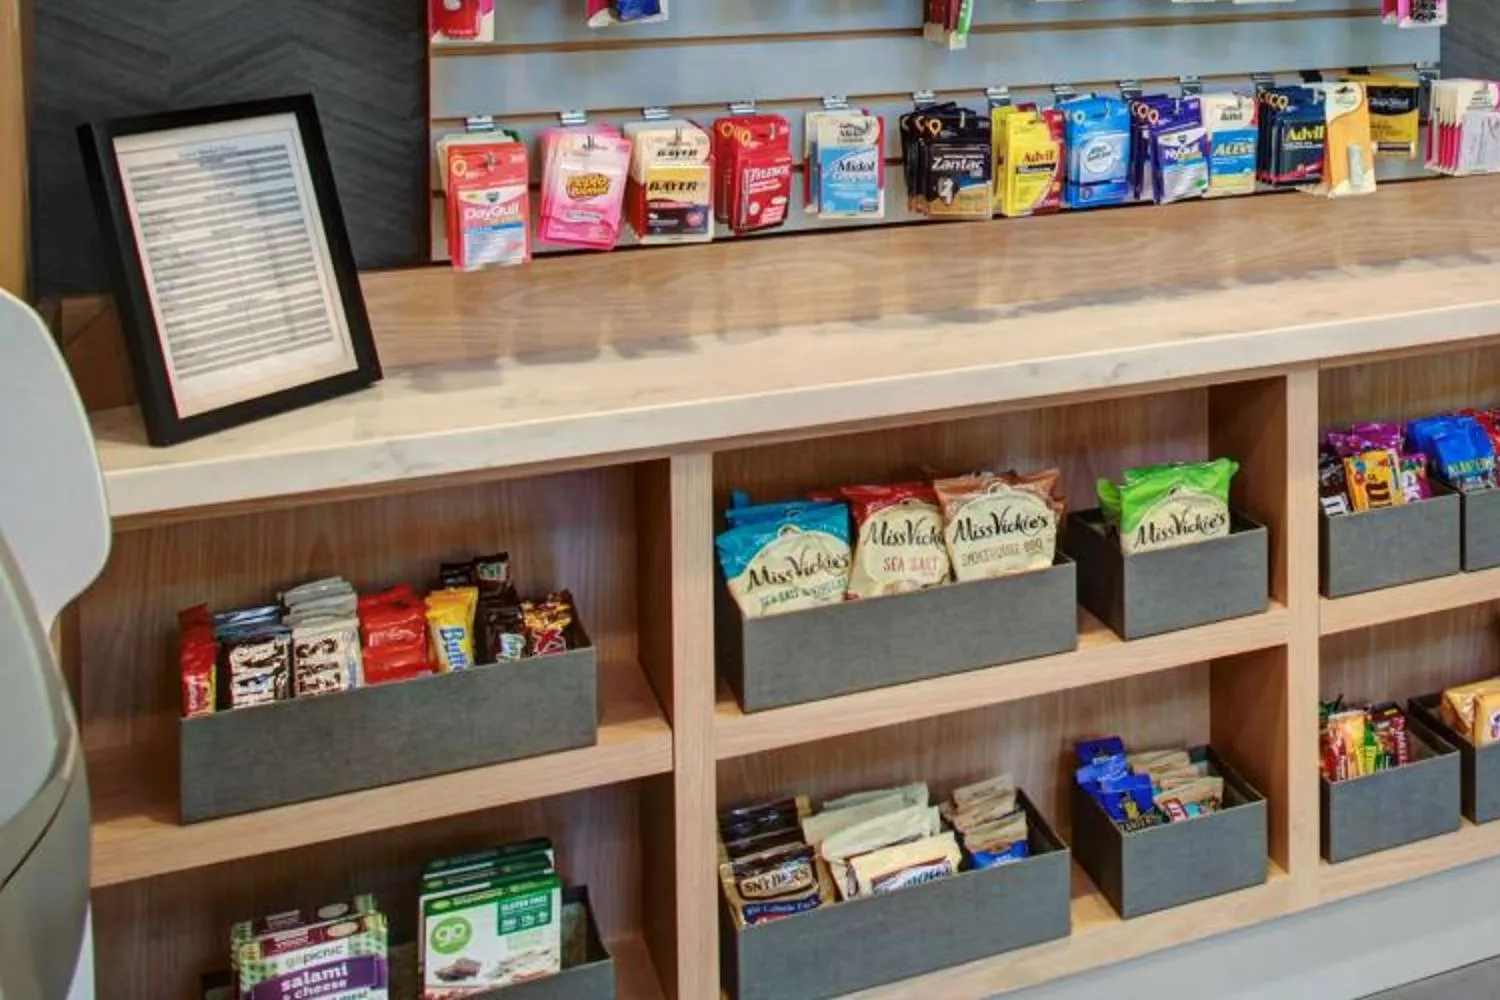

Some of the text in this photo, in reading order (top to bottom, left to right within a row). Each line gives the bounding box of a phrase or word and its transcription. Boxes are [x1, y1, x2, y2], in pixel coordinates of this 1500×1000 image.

[1289, 125, 1325, 141] Advil
[931, 156, 984, 172] Zantac
[1022, 150, 1056, 163] Advil
[648, 181, 699, 192] BAYER
[866, 518, 905, 547] Miss
[954, 504, 1049, 545] Miss Vickie's
[1133, 505, 1226, 549] Miss Vickie's
[745, 561, 796, 595] Miss
[786, 541, 849, 578] Vickie's
[883, 555, 906, 573] SEA
[280, 961, 349, 992] salami
